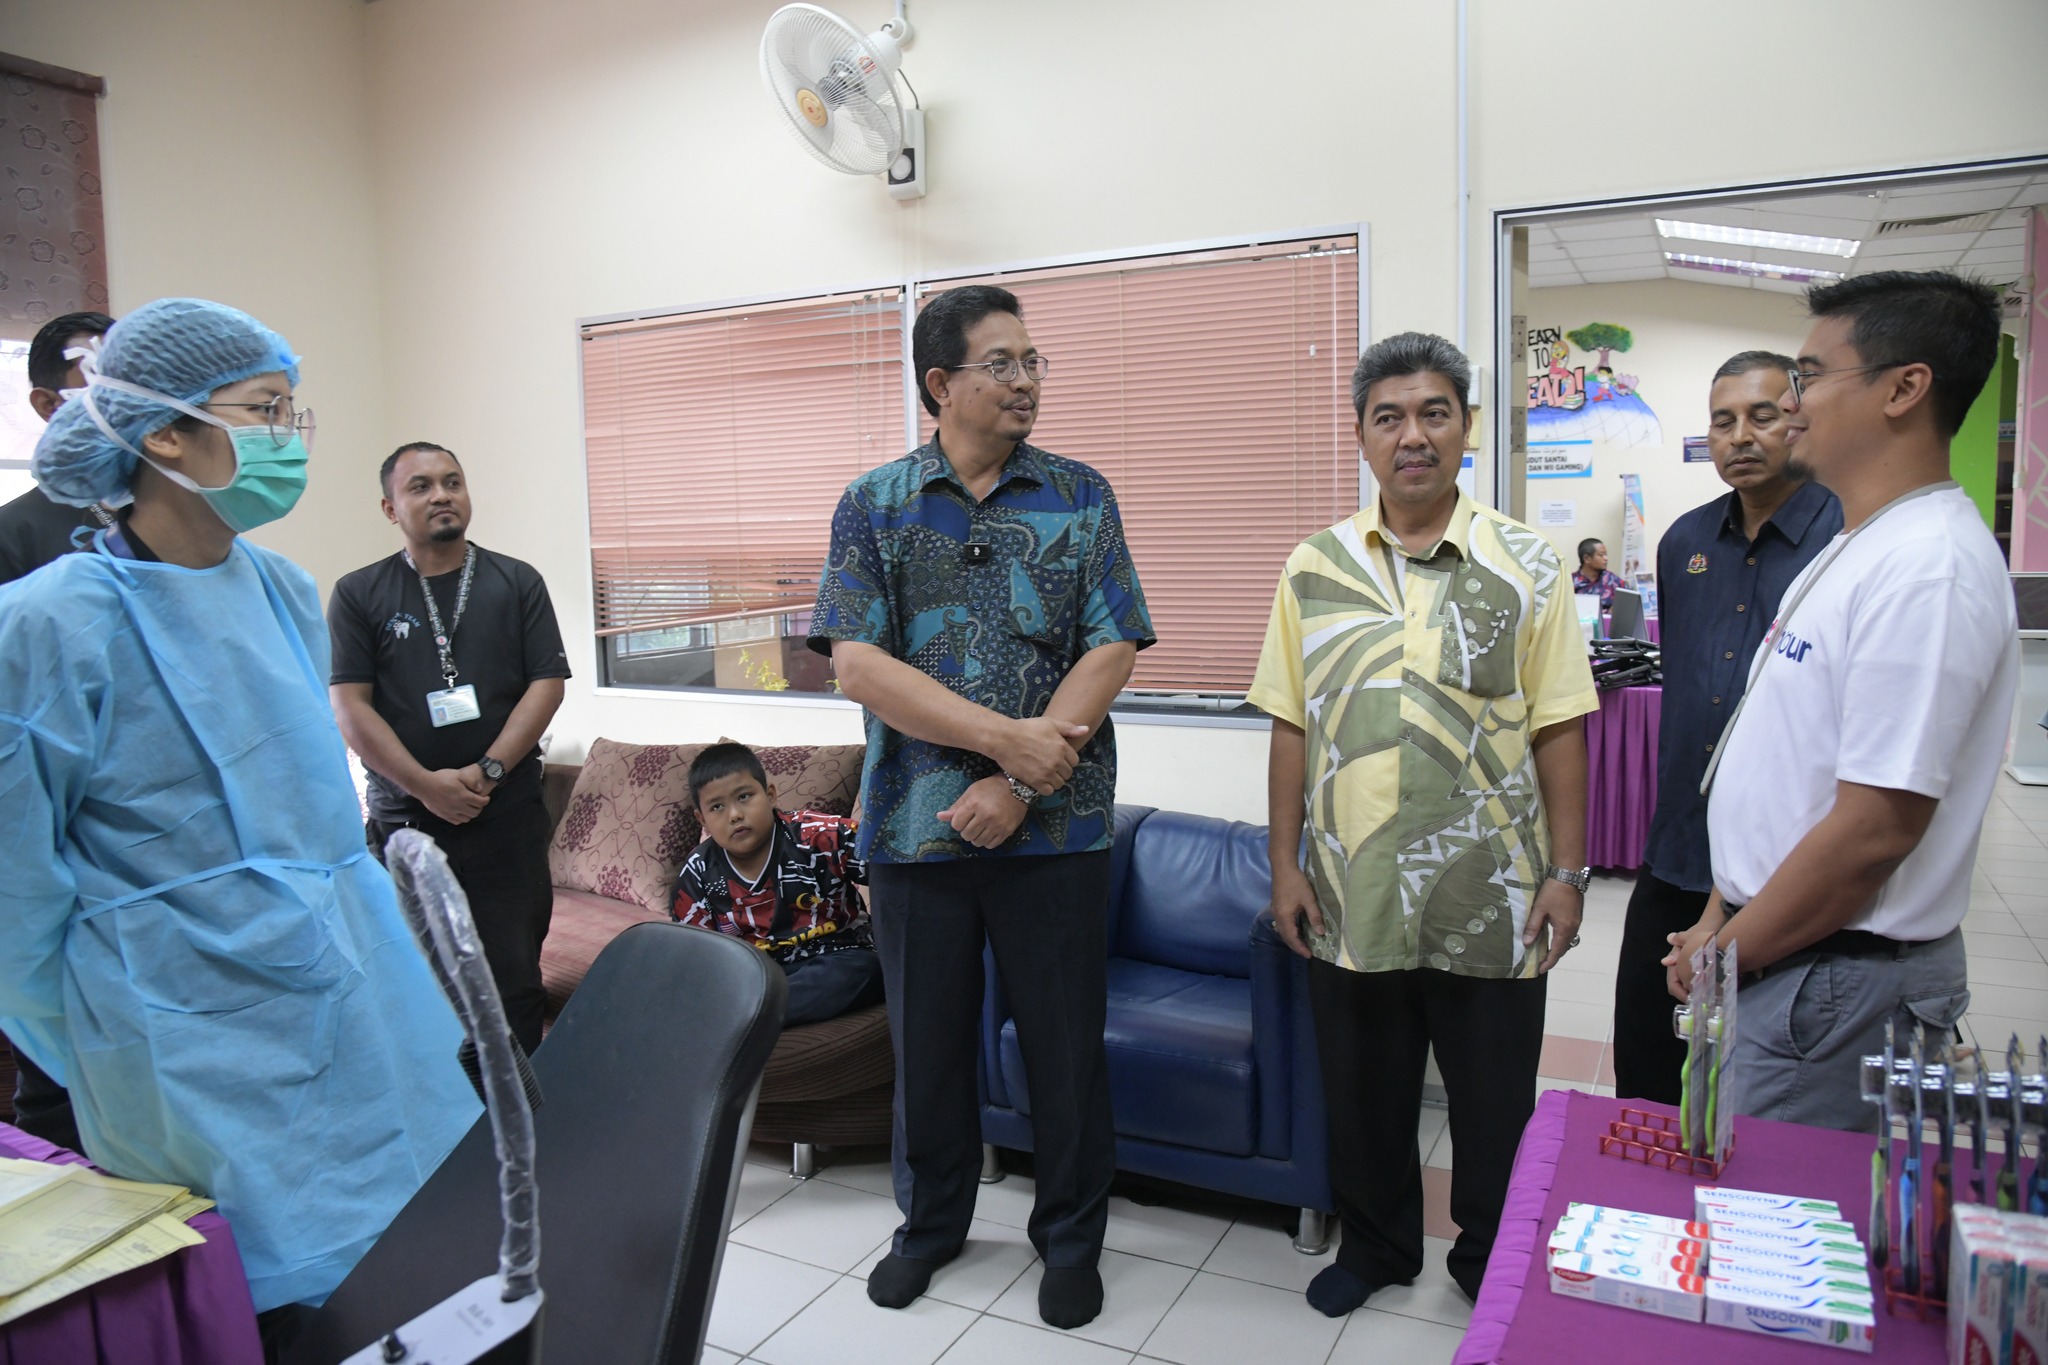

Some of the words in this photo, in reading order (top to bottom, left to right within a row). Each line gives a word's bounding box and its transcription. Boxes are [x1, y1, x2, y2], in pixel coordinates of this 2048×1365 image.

[1527, 326, 1561, 346] EARN
[1533, 347, 1550, 370] TO
[1527, 366, 1586, 410] EAD!
[1703, 1190, 1780, 1204] SENSODYNE
[1714, 1208, 1793, 1224] SENSODYNE
[1720, 1225, 1801, 1243] SENSODYNE
[1718, 1243, 1802, 1261] SENSODYNE
[1556, 1269, 1589, 1280] Colgate
[1718, 1262, 1804, 1282] SENSODYNE
[1715, 1282, 1802, 1302] SENSODYNE
[1745, 1306, 1824, 1328] SENSODYNE
